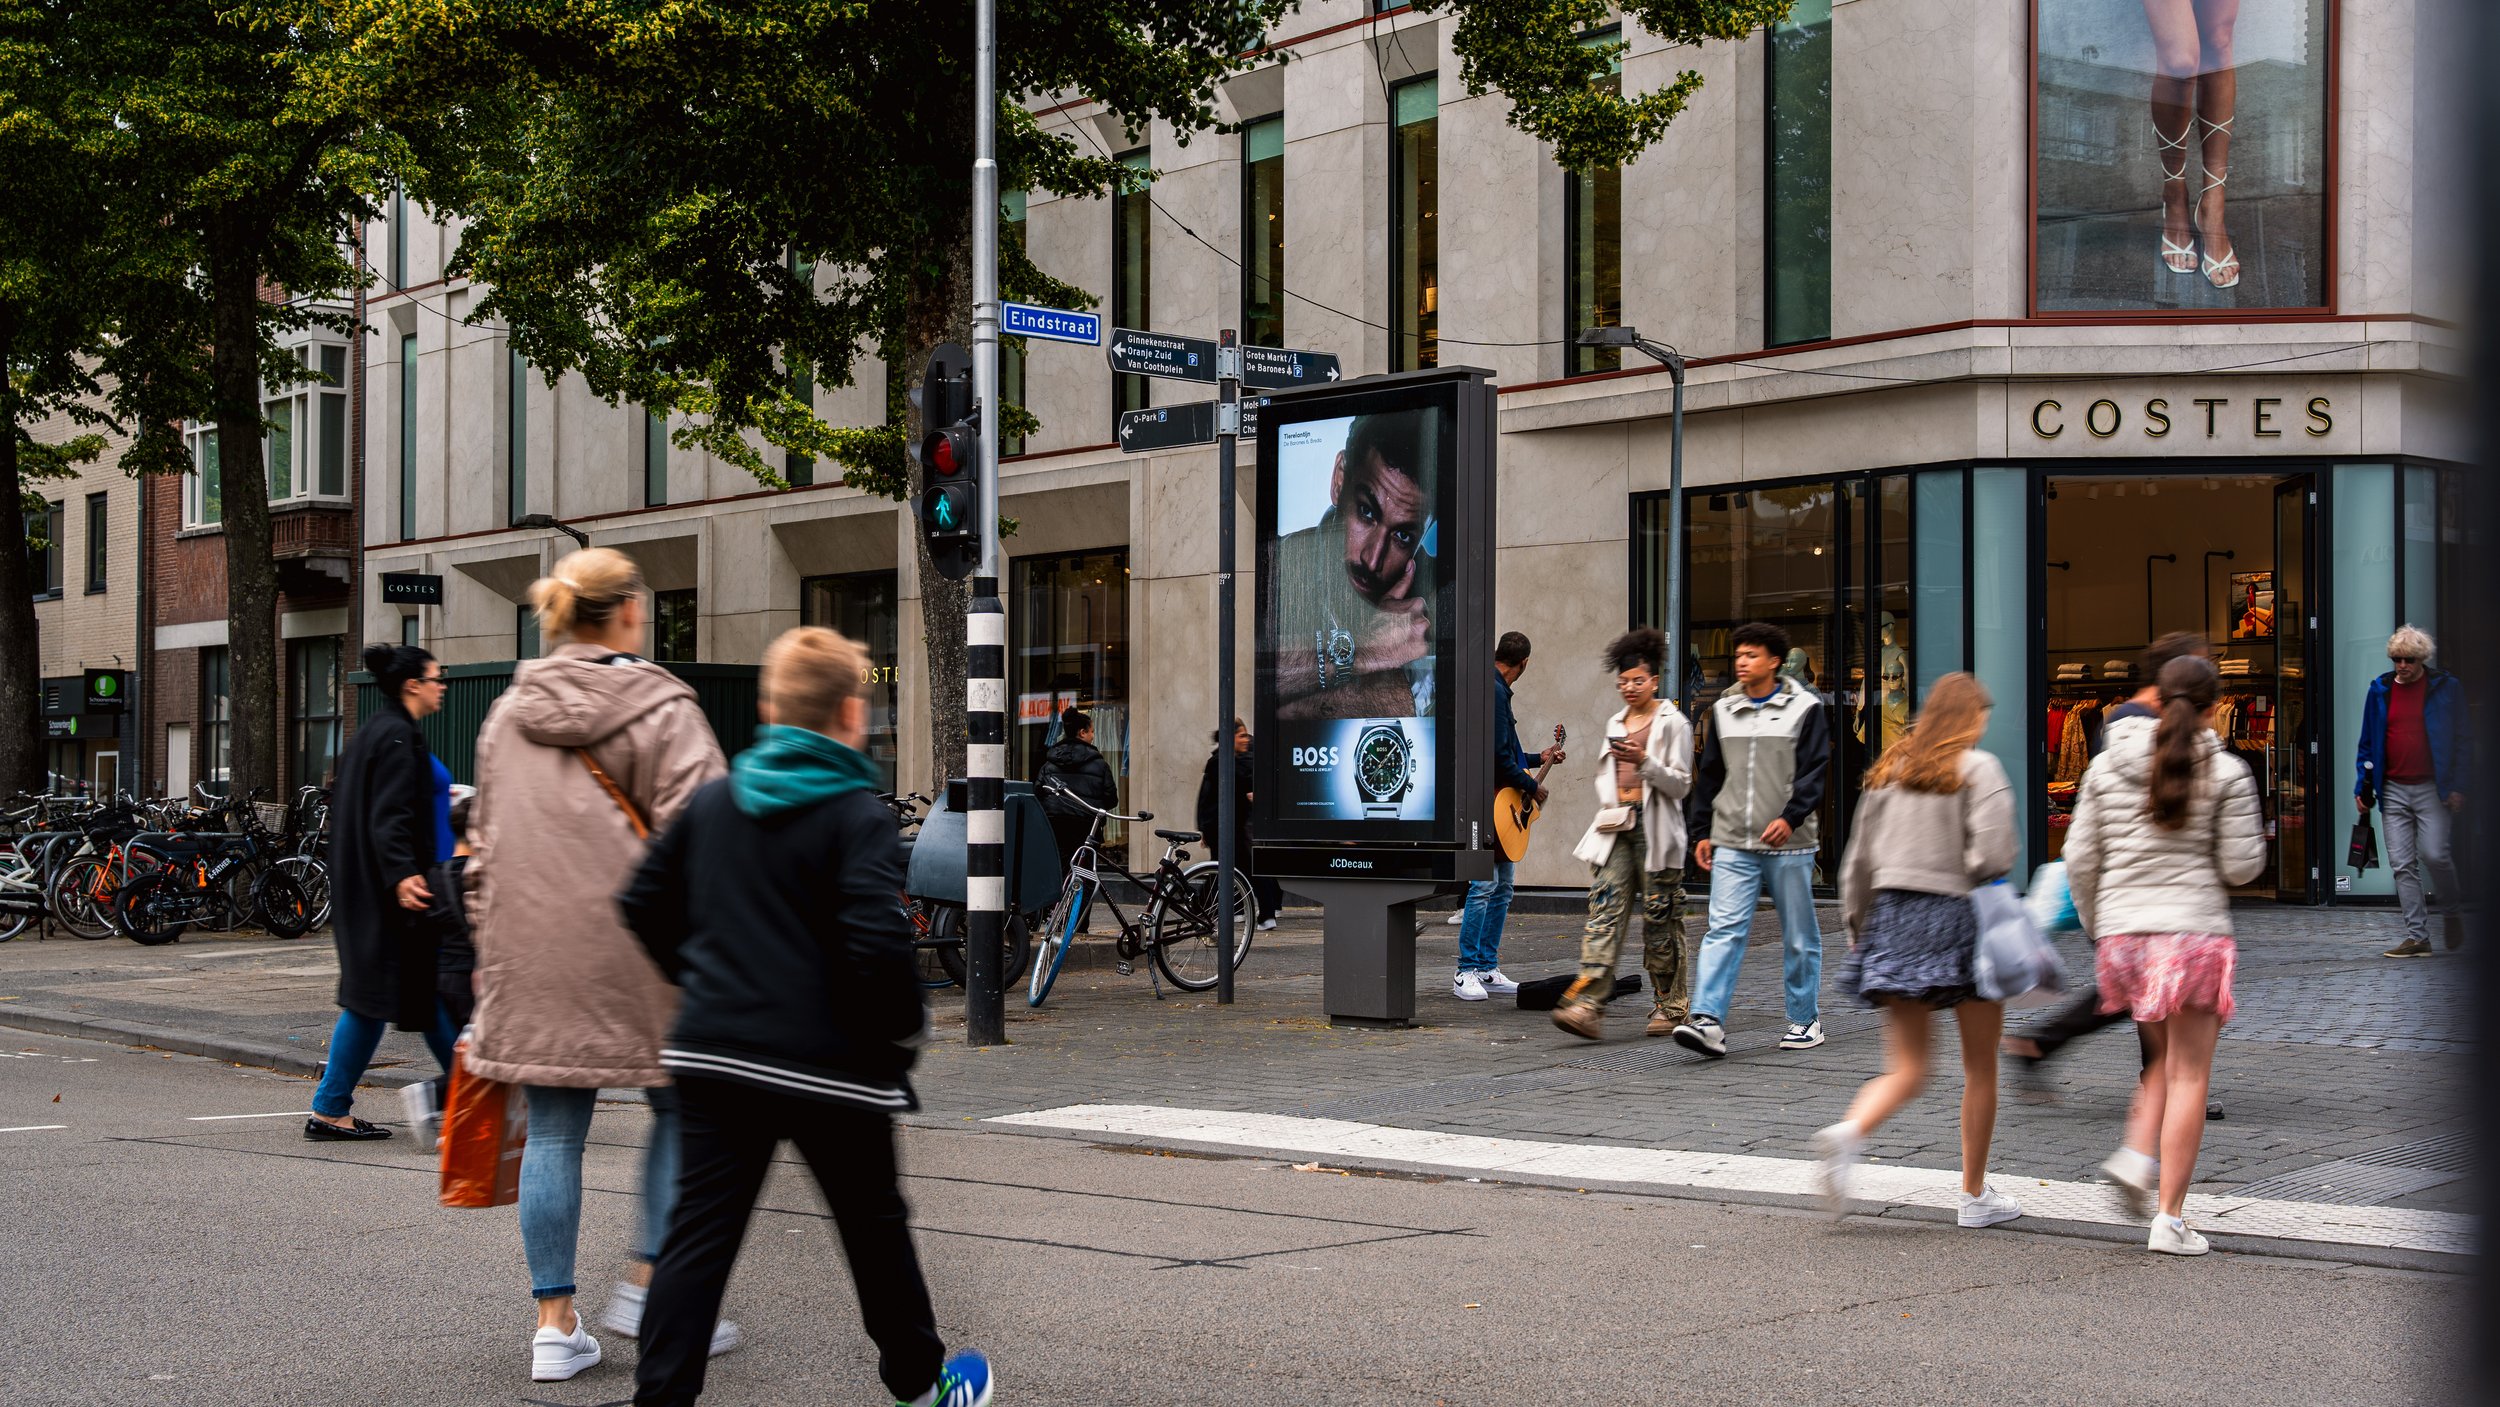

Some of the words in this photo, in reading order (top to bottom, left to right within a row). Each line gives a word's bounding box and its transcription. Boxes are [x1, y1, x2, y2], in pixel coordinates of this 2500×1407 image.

[1011, 310, 1092, 335] Eindstraat
[1127, 334, 1185, 350] Ginnekenstraat
[1127, 346, 1153, 360] Oranje
[1154, 349, 1172, 360] Zuid
[1246, 350, 1265, 360] Grote
[1267, 353, 1287, 362] Markt
[1127, 359, 1141, 369] Van
[1143, 361, 1183, 374] Coothplein
[1246, 362, 1256, 371] De
[1257, 363, 1286, 374] Barones
[2031, 397, 2333, 438] COSTES
[388, 584, 435, 594] COSTES
[1293, 746, 1340, 766] BOSS
[207, 857, 232, 880] E-FATHER
[1330, 858, 1373, 869] JCDecaux
